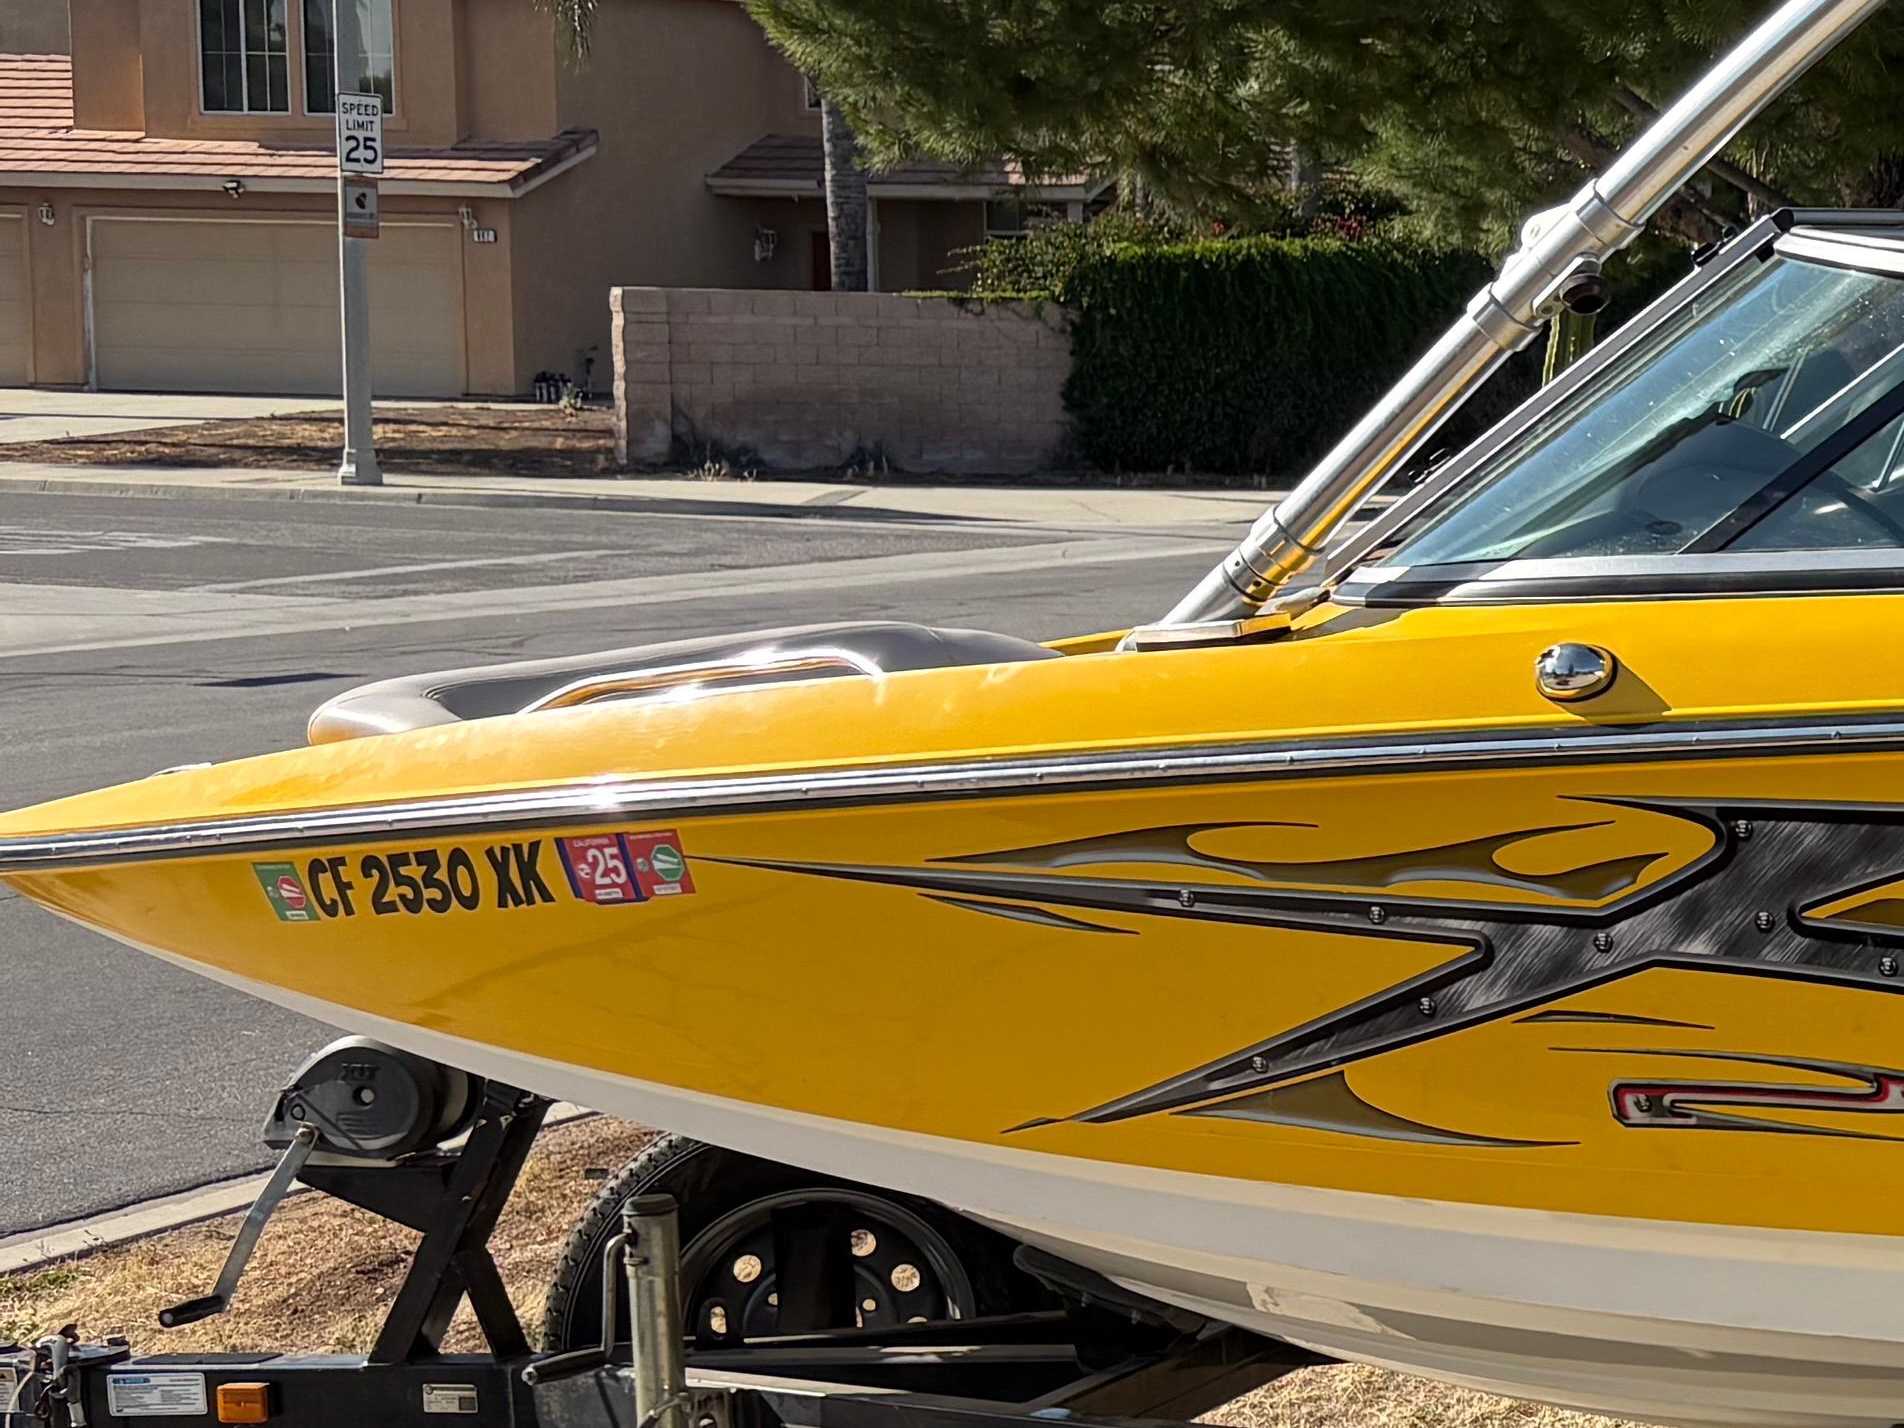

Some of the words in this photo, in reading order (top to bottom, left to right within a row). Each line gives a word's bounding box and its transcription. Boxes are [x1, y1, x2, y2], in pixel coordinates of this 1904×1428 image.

[342, 102, 379, 117] SPEED
[345, 118, 376, 132] LIMIT
[345, 135, 378, 165] 25
[308, 857, 355, 918] CF
[361, 847, 481, 915] 2530
[485, 839, 556, 908] XK
[587, 847, 628, 885] 25
